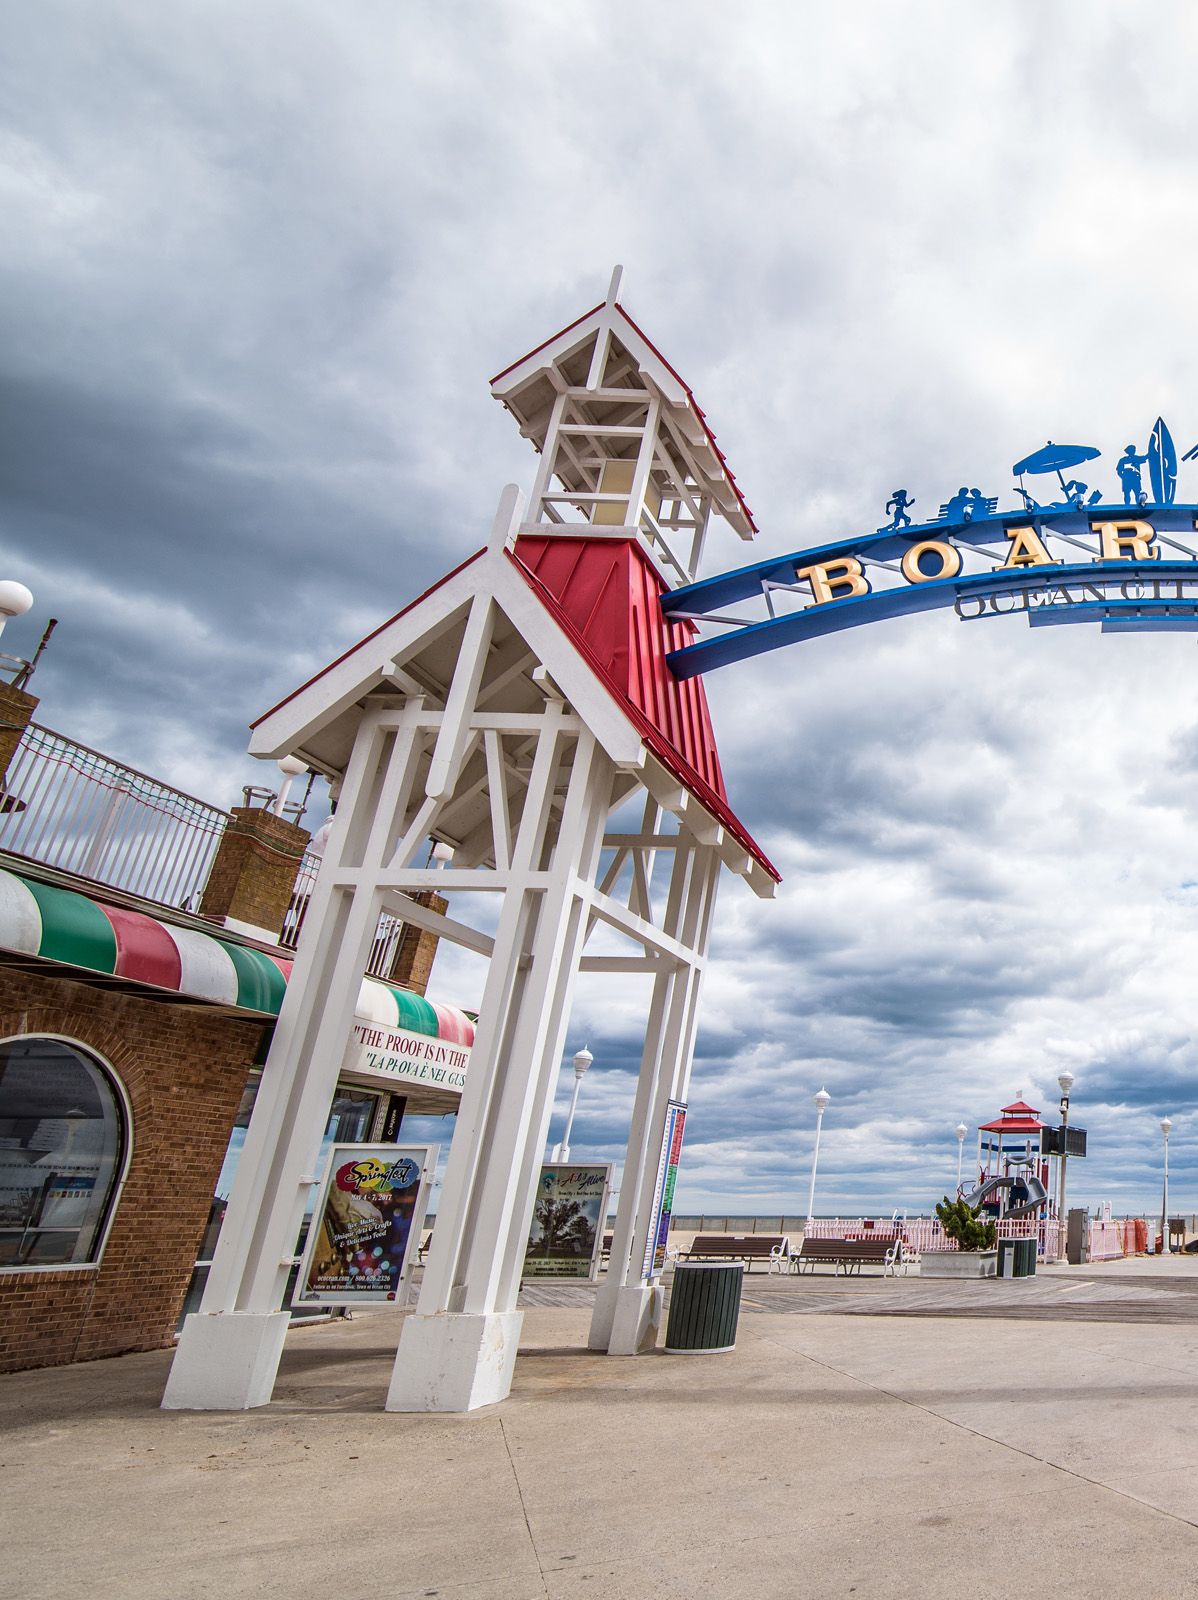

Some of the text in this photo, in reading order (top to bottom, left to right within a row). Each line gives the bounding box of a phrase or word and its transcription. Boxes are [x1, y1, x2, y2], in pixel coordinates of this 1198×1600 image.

[954, 581, 1107, 618] OCEAN
[353, 1025, 469, 1069] "THE PROOF IS IN THE
[344, 1158, 412, 1190] Springfest
